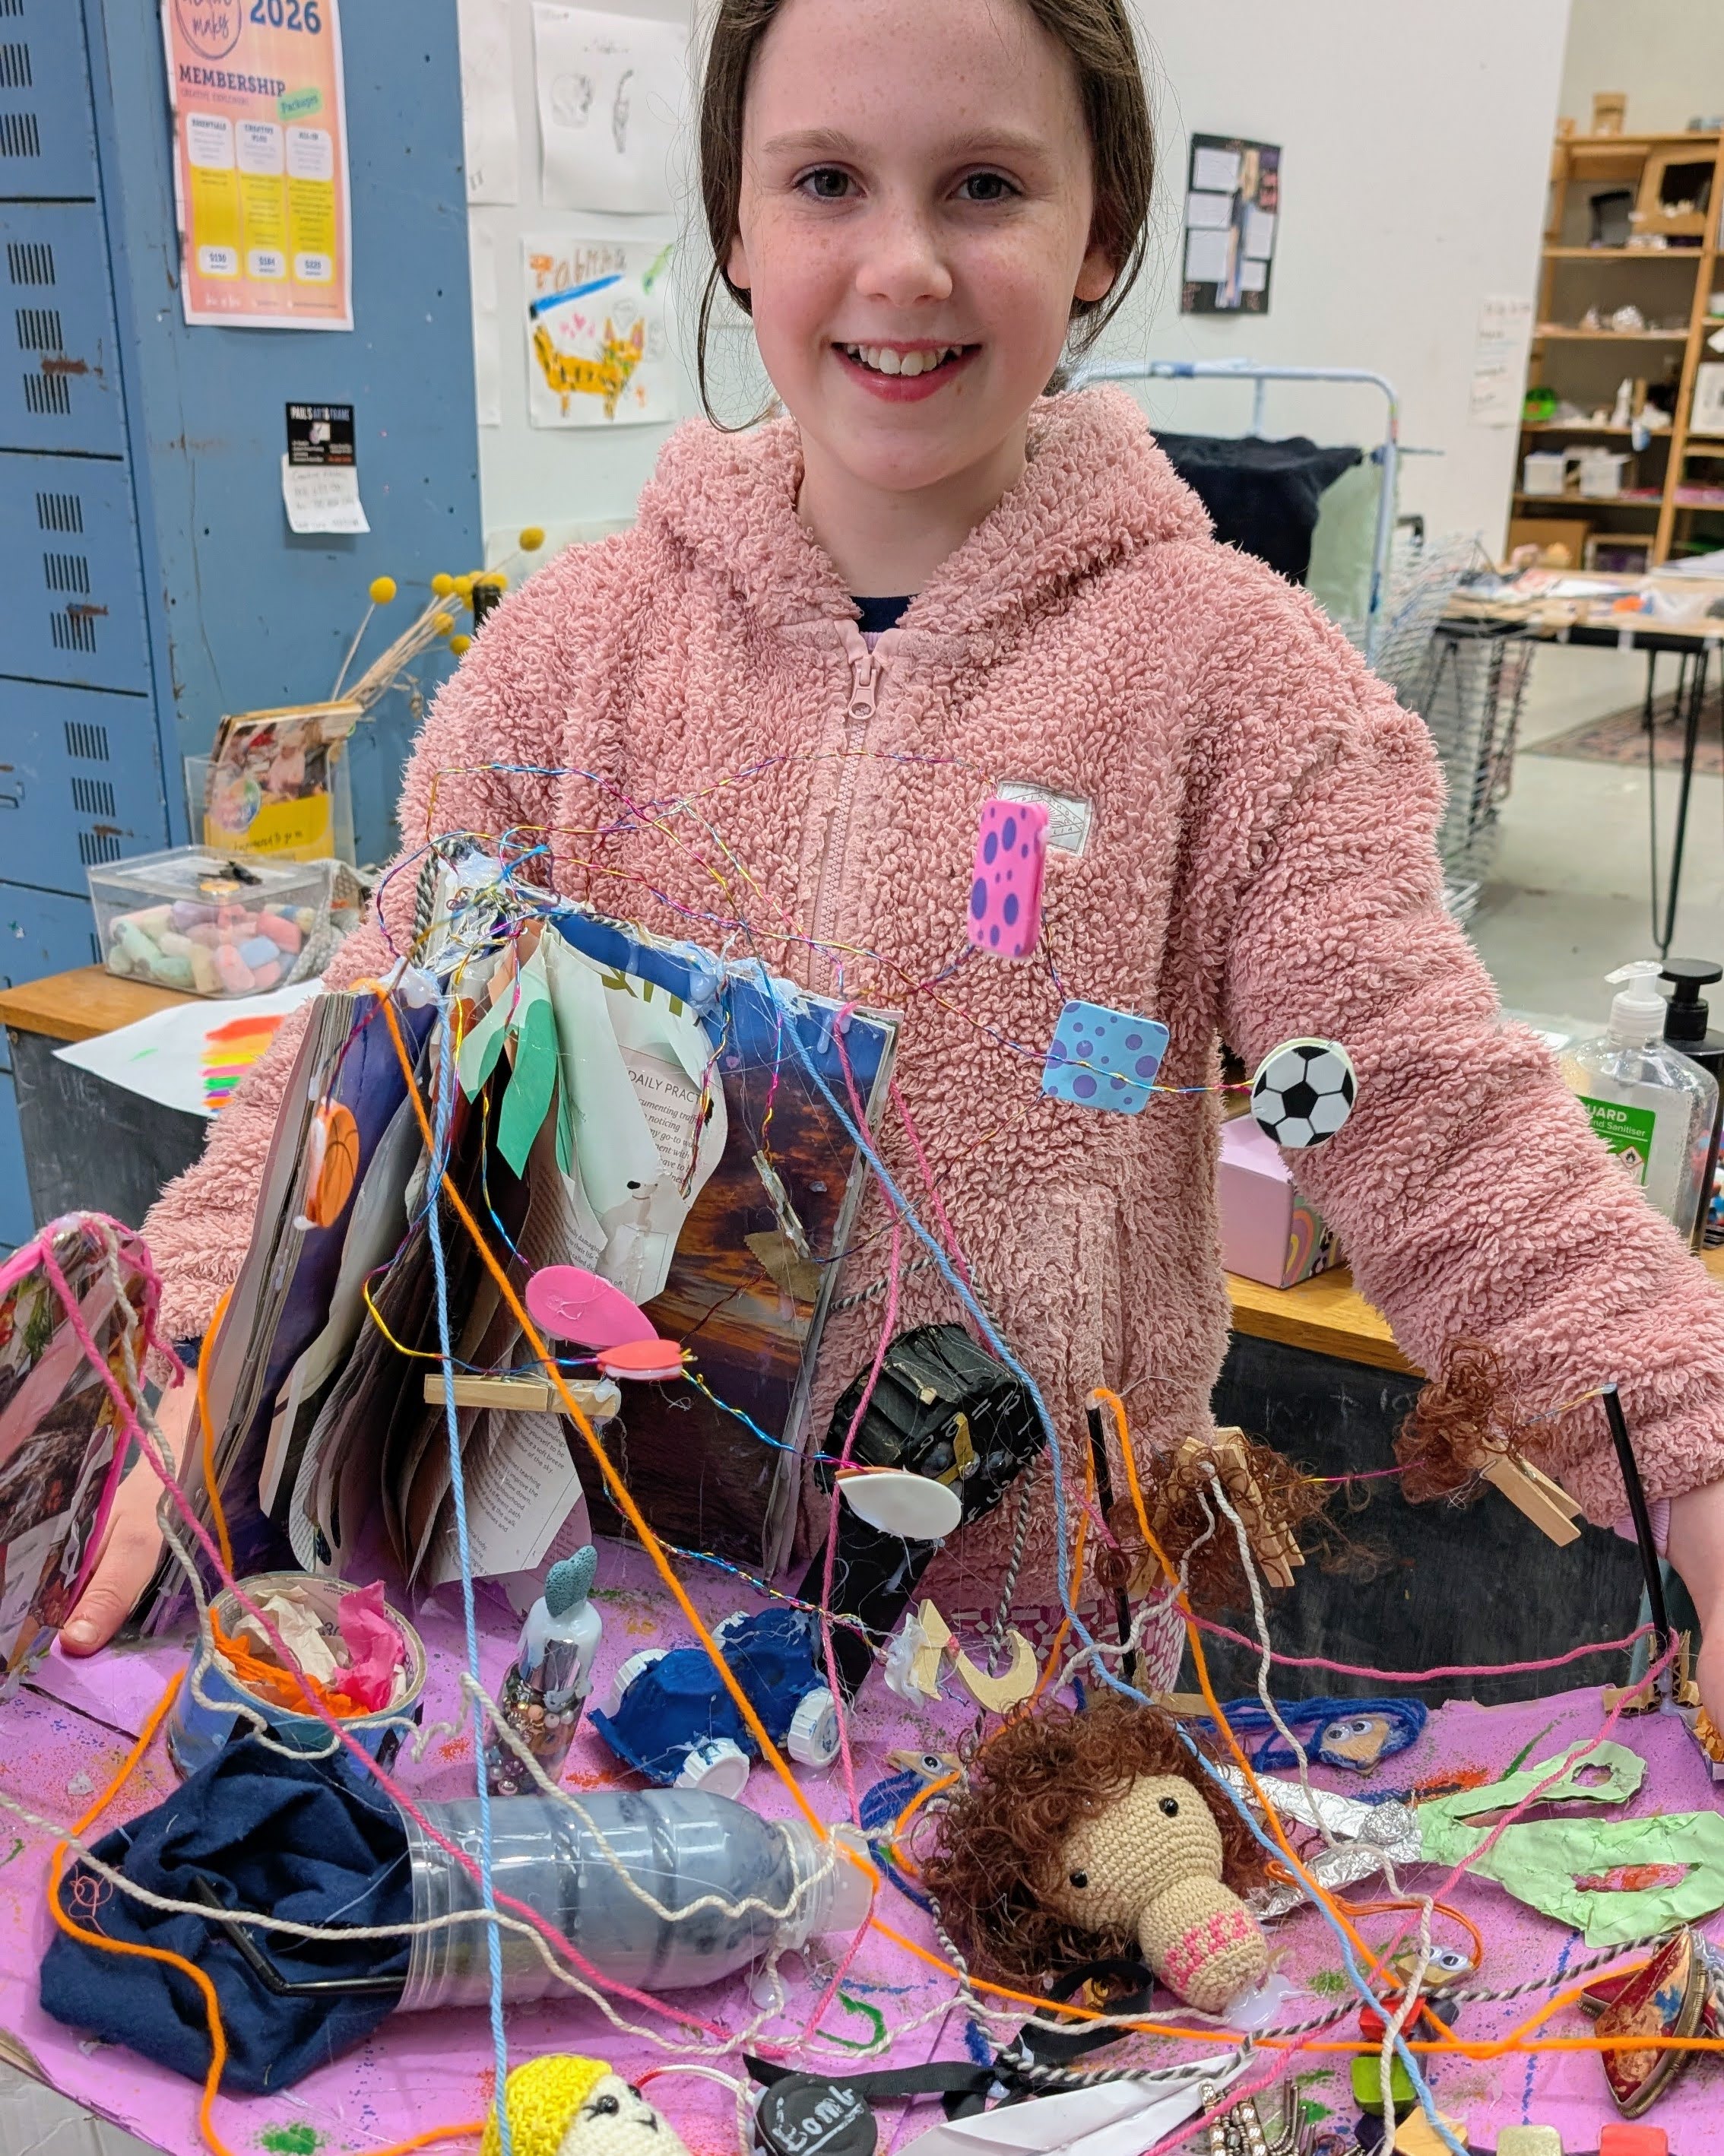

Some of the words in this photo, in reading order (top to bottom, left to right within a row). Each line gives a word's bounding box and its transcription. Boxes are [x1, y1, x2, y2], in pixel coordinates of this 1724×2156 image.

[249, 0, 322, 34] 2026
[179, 63, 286, 97] MEMBERSHIP
[1057, 804, 1076, 822] HOT
[628, 1070, 664, 1091] DAILY
[648, 1114, 681, 1133] noticing
[1606, 1121, 1646, 1137] Sanitiser
[661, 1130, 681, 1145] go-to
[673, 1149, 689, 1160] with
[574, 1241, 585, 1254] their
[572, 1252, 587, 1267] called
[529, 1429, 551, 1447] yourself
[550, 1444, 556, 1453] to
[534, 1421, 566, 1448] surroundings
[534, 1455, 544, 1466] the
[543, 1463, 554, 1475] sky.
[536, 1446, 547, 1457] soft
[546, 1453, 565, 1470] breeze
[510, 1472, 529, 1491] improve
[528, 1487, 539, 1498] the
[519, 1467, 541, 1490] teaching
[491, 1490, 509, 1510] different
[508, 1508, 521, 1520] path
[515, 1489, 531, 1505] down.
[498, 1522, 509, 1533] and
